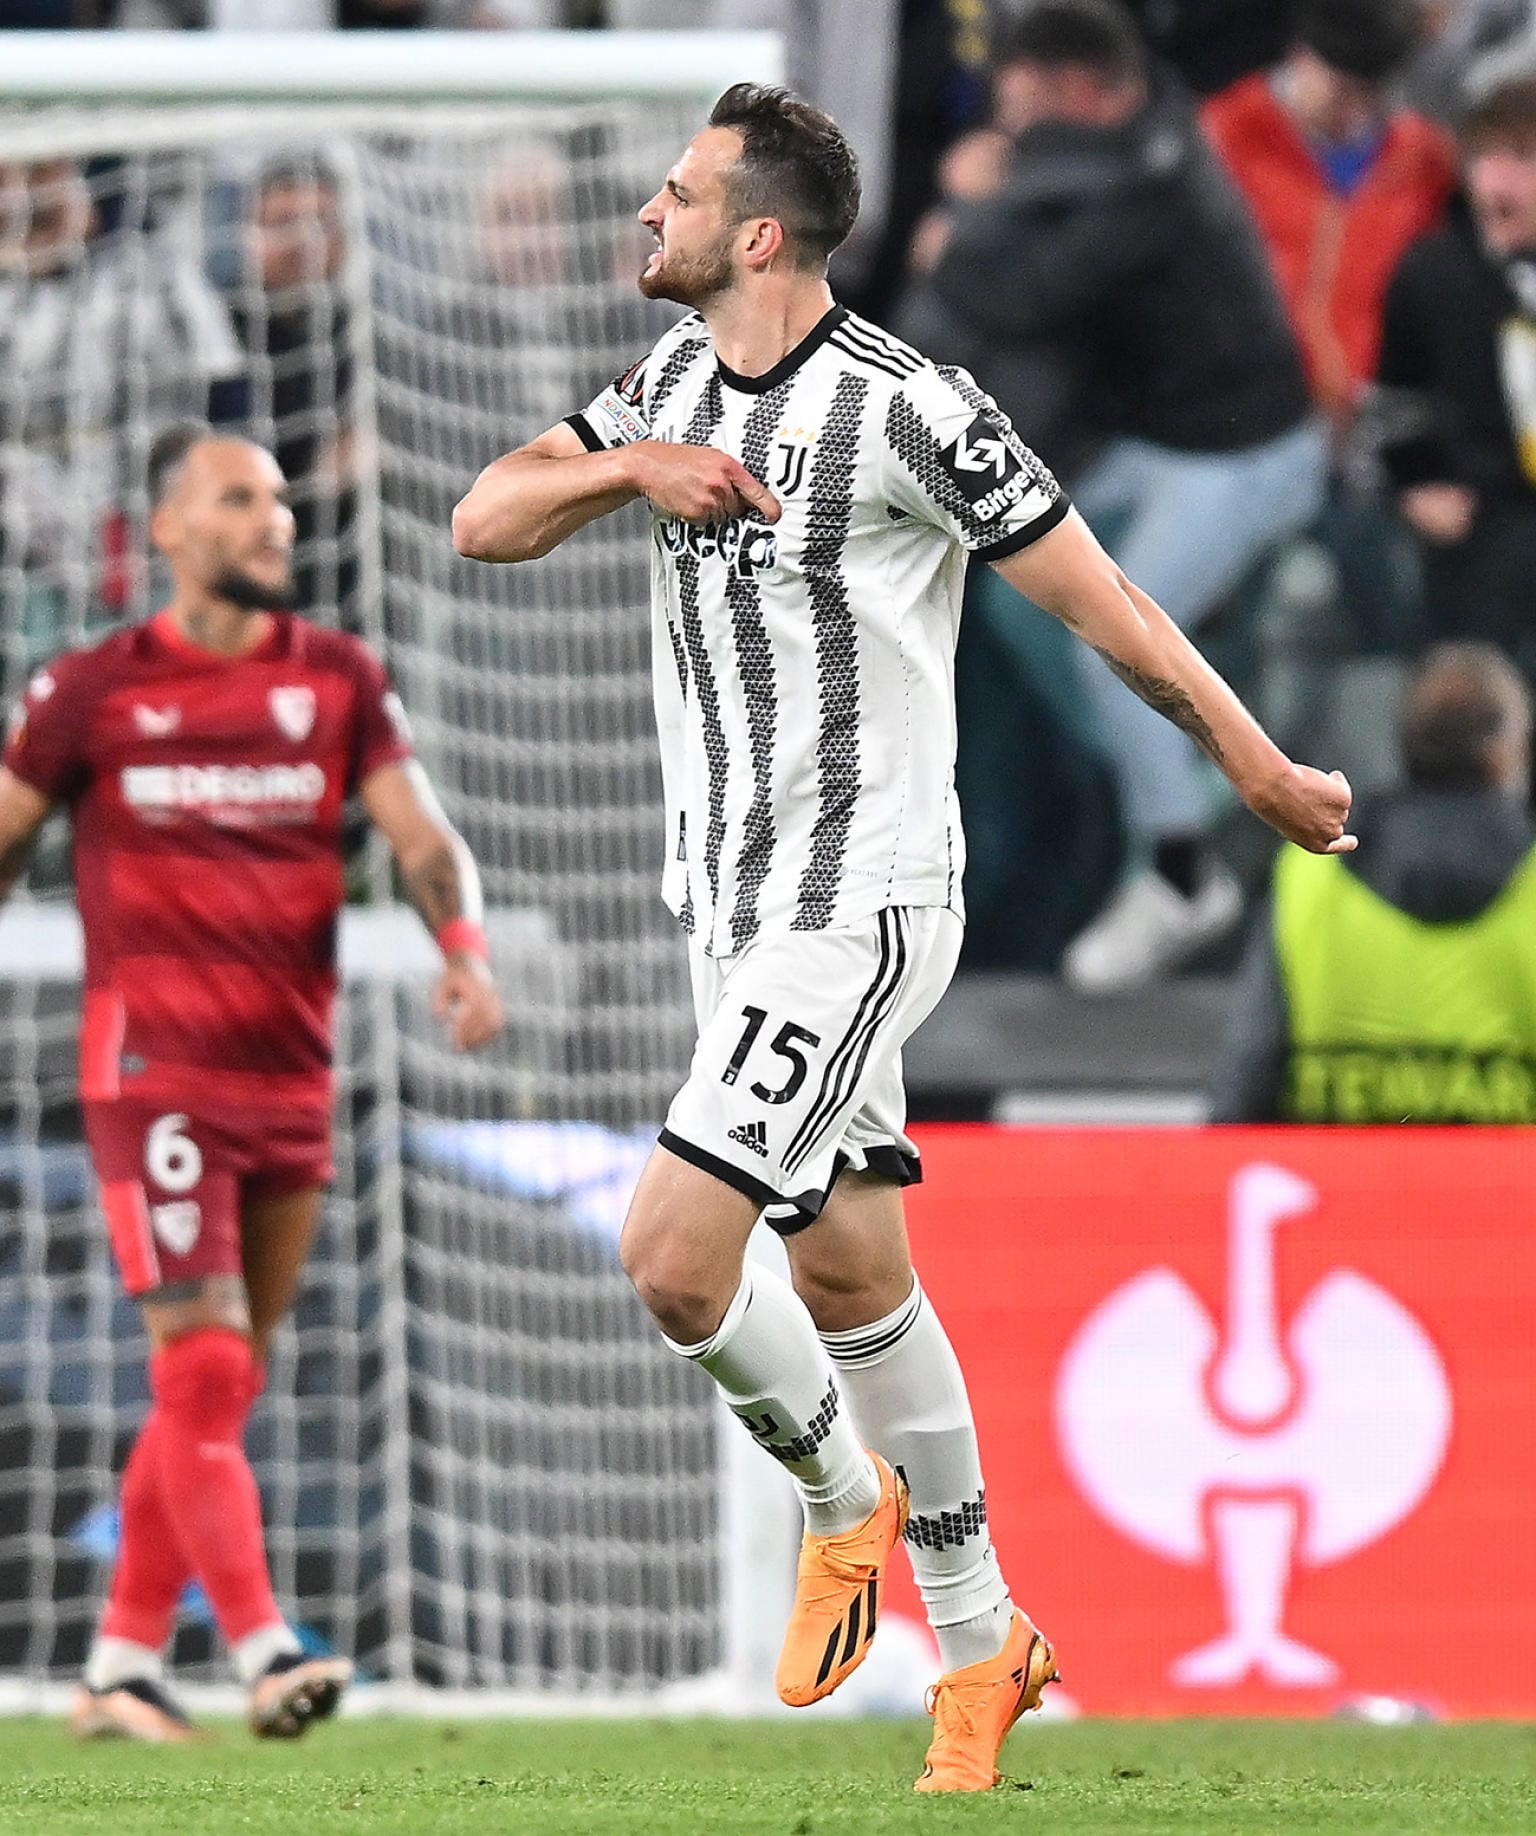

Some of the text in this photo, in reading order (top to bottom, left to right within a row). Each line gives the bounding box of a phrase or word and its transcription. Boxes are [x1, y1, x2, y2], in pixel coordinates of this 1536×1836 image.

[721, 1005, 822, 1105] 15
[146, 1112, 203, 1193] 6
[727, 1129, 770, 1159] adidas
